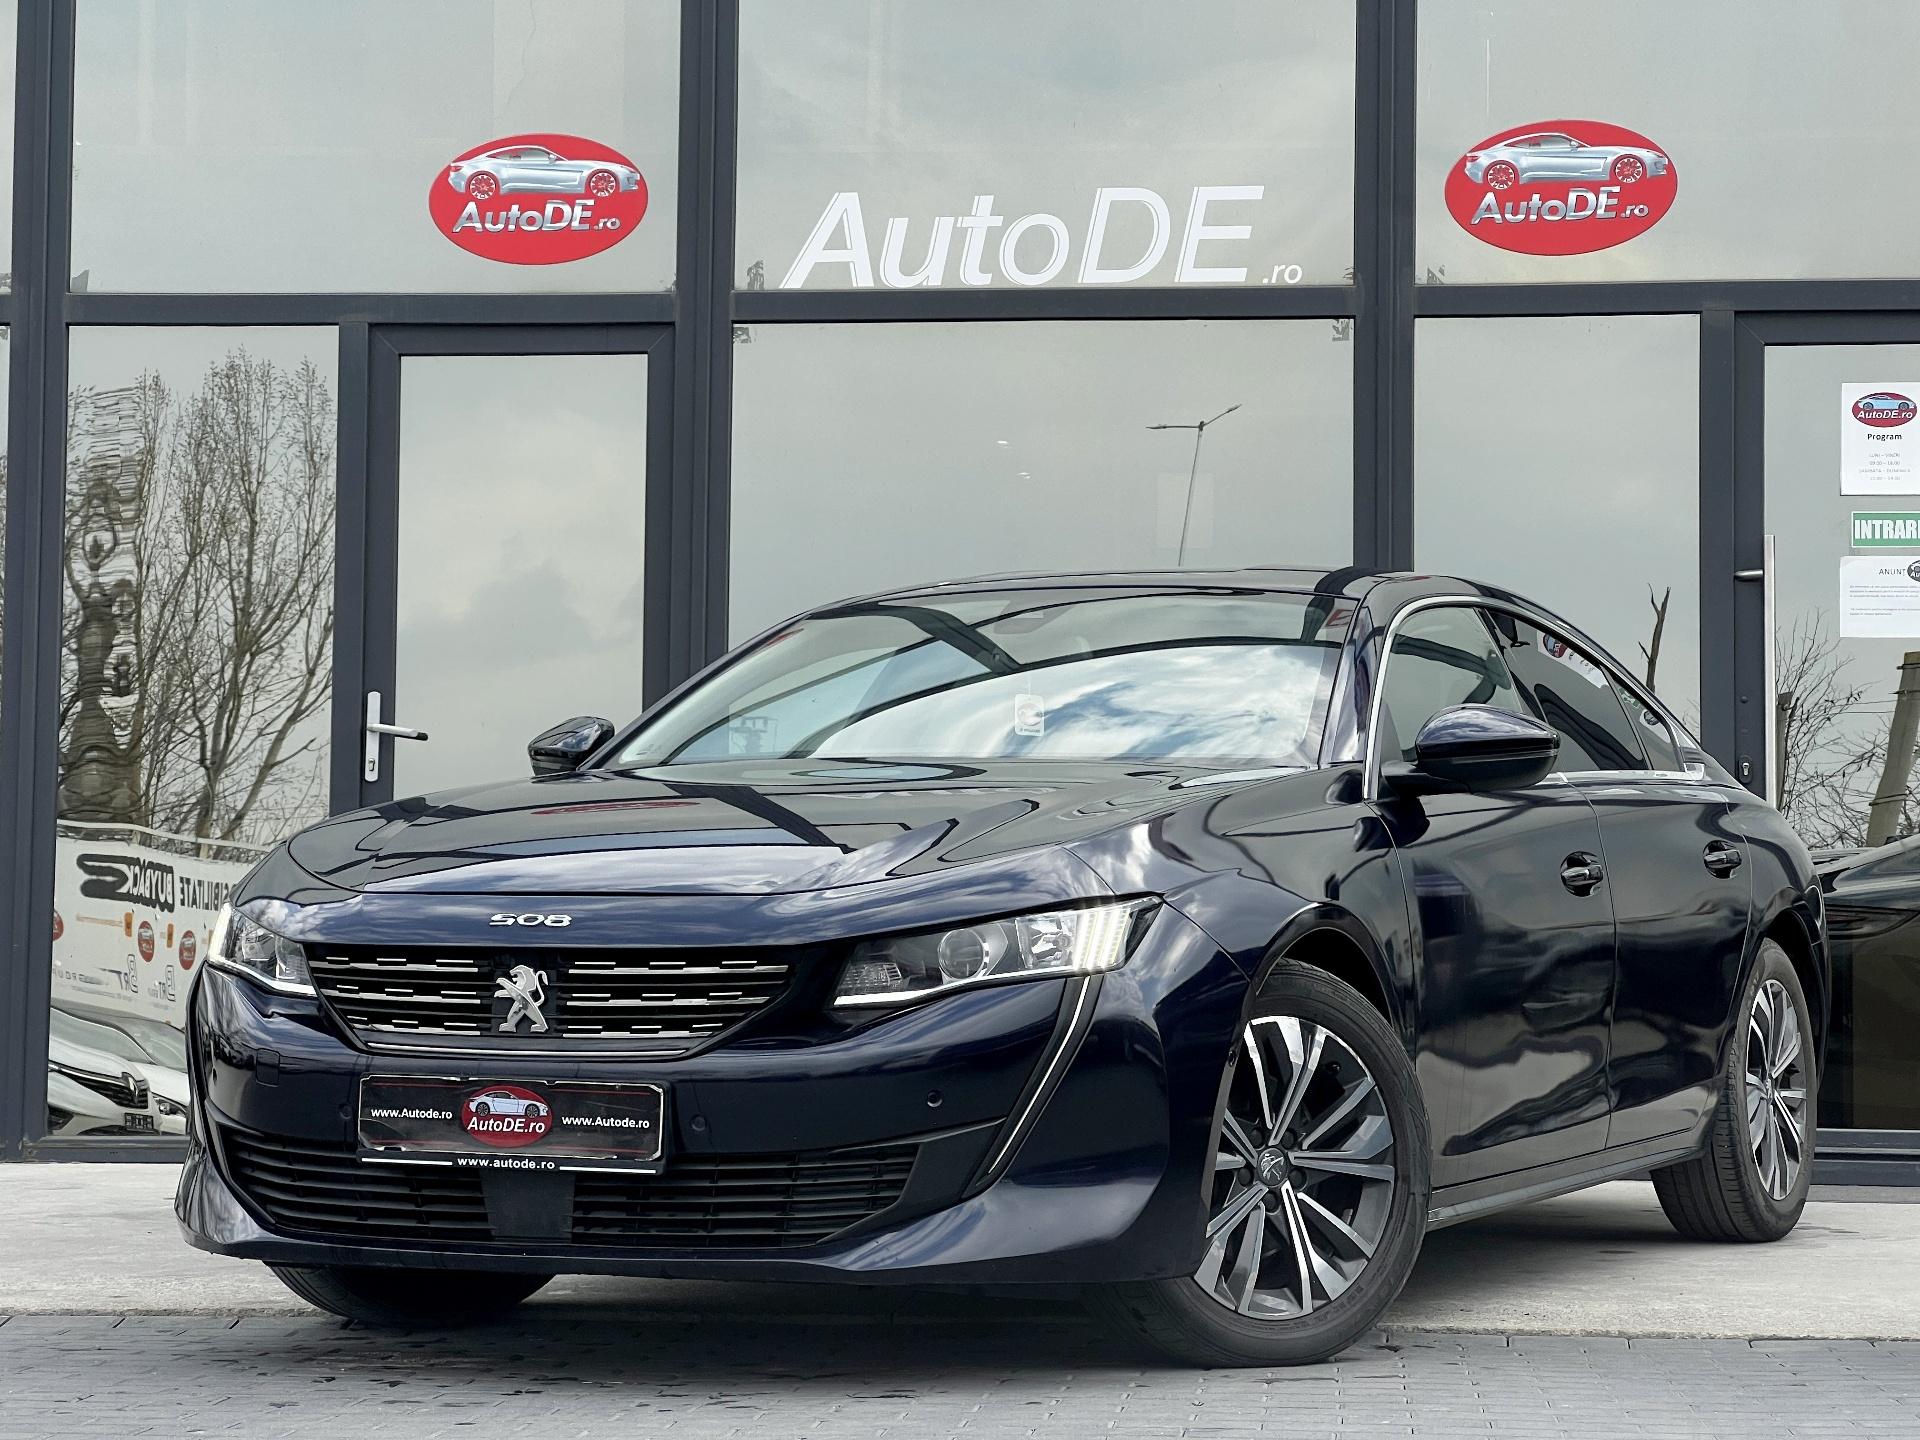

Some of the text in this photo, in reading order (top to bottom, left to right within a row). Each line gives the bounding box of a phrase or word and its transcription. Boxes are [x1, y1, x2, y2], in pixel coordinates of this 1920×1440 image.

[1857, 409, 1913, 419] AutoDE.ro
[1867, 433, 1903, 441] Program
[1854, 519, 1920, 539] INTRAR
[489, 913, 572, 927] 508
[370, 1107, 453, 1120] www.Autode.ro
[467, 1116, 545, 1134] AutoDE.ro
[561, 1116, 650, 1129] www.Autode.ro
[457, 1156, 555, 1170] www.autode.ro
